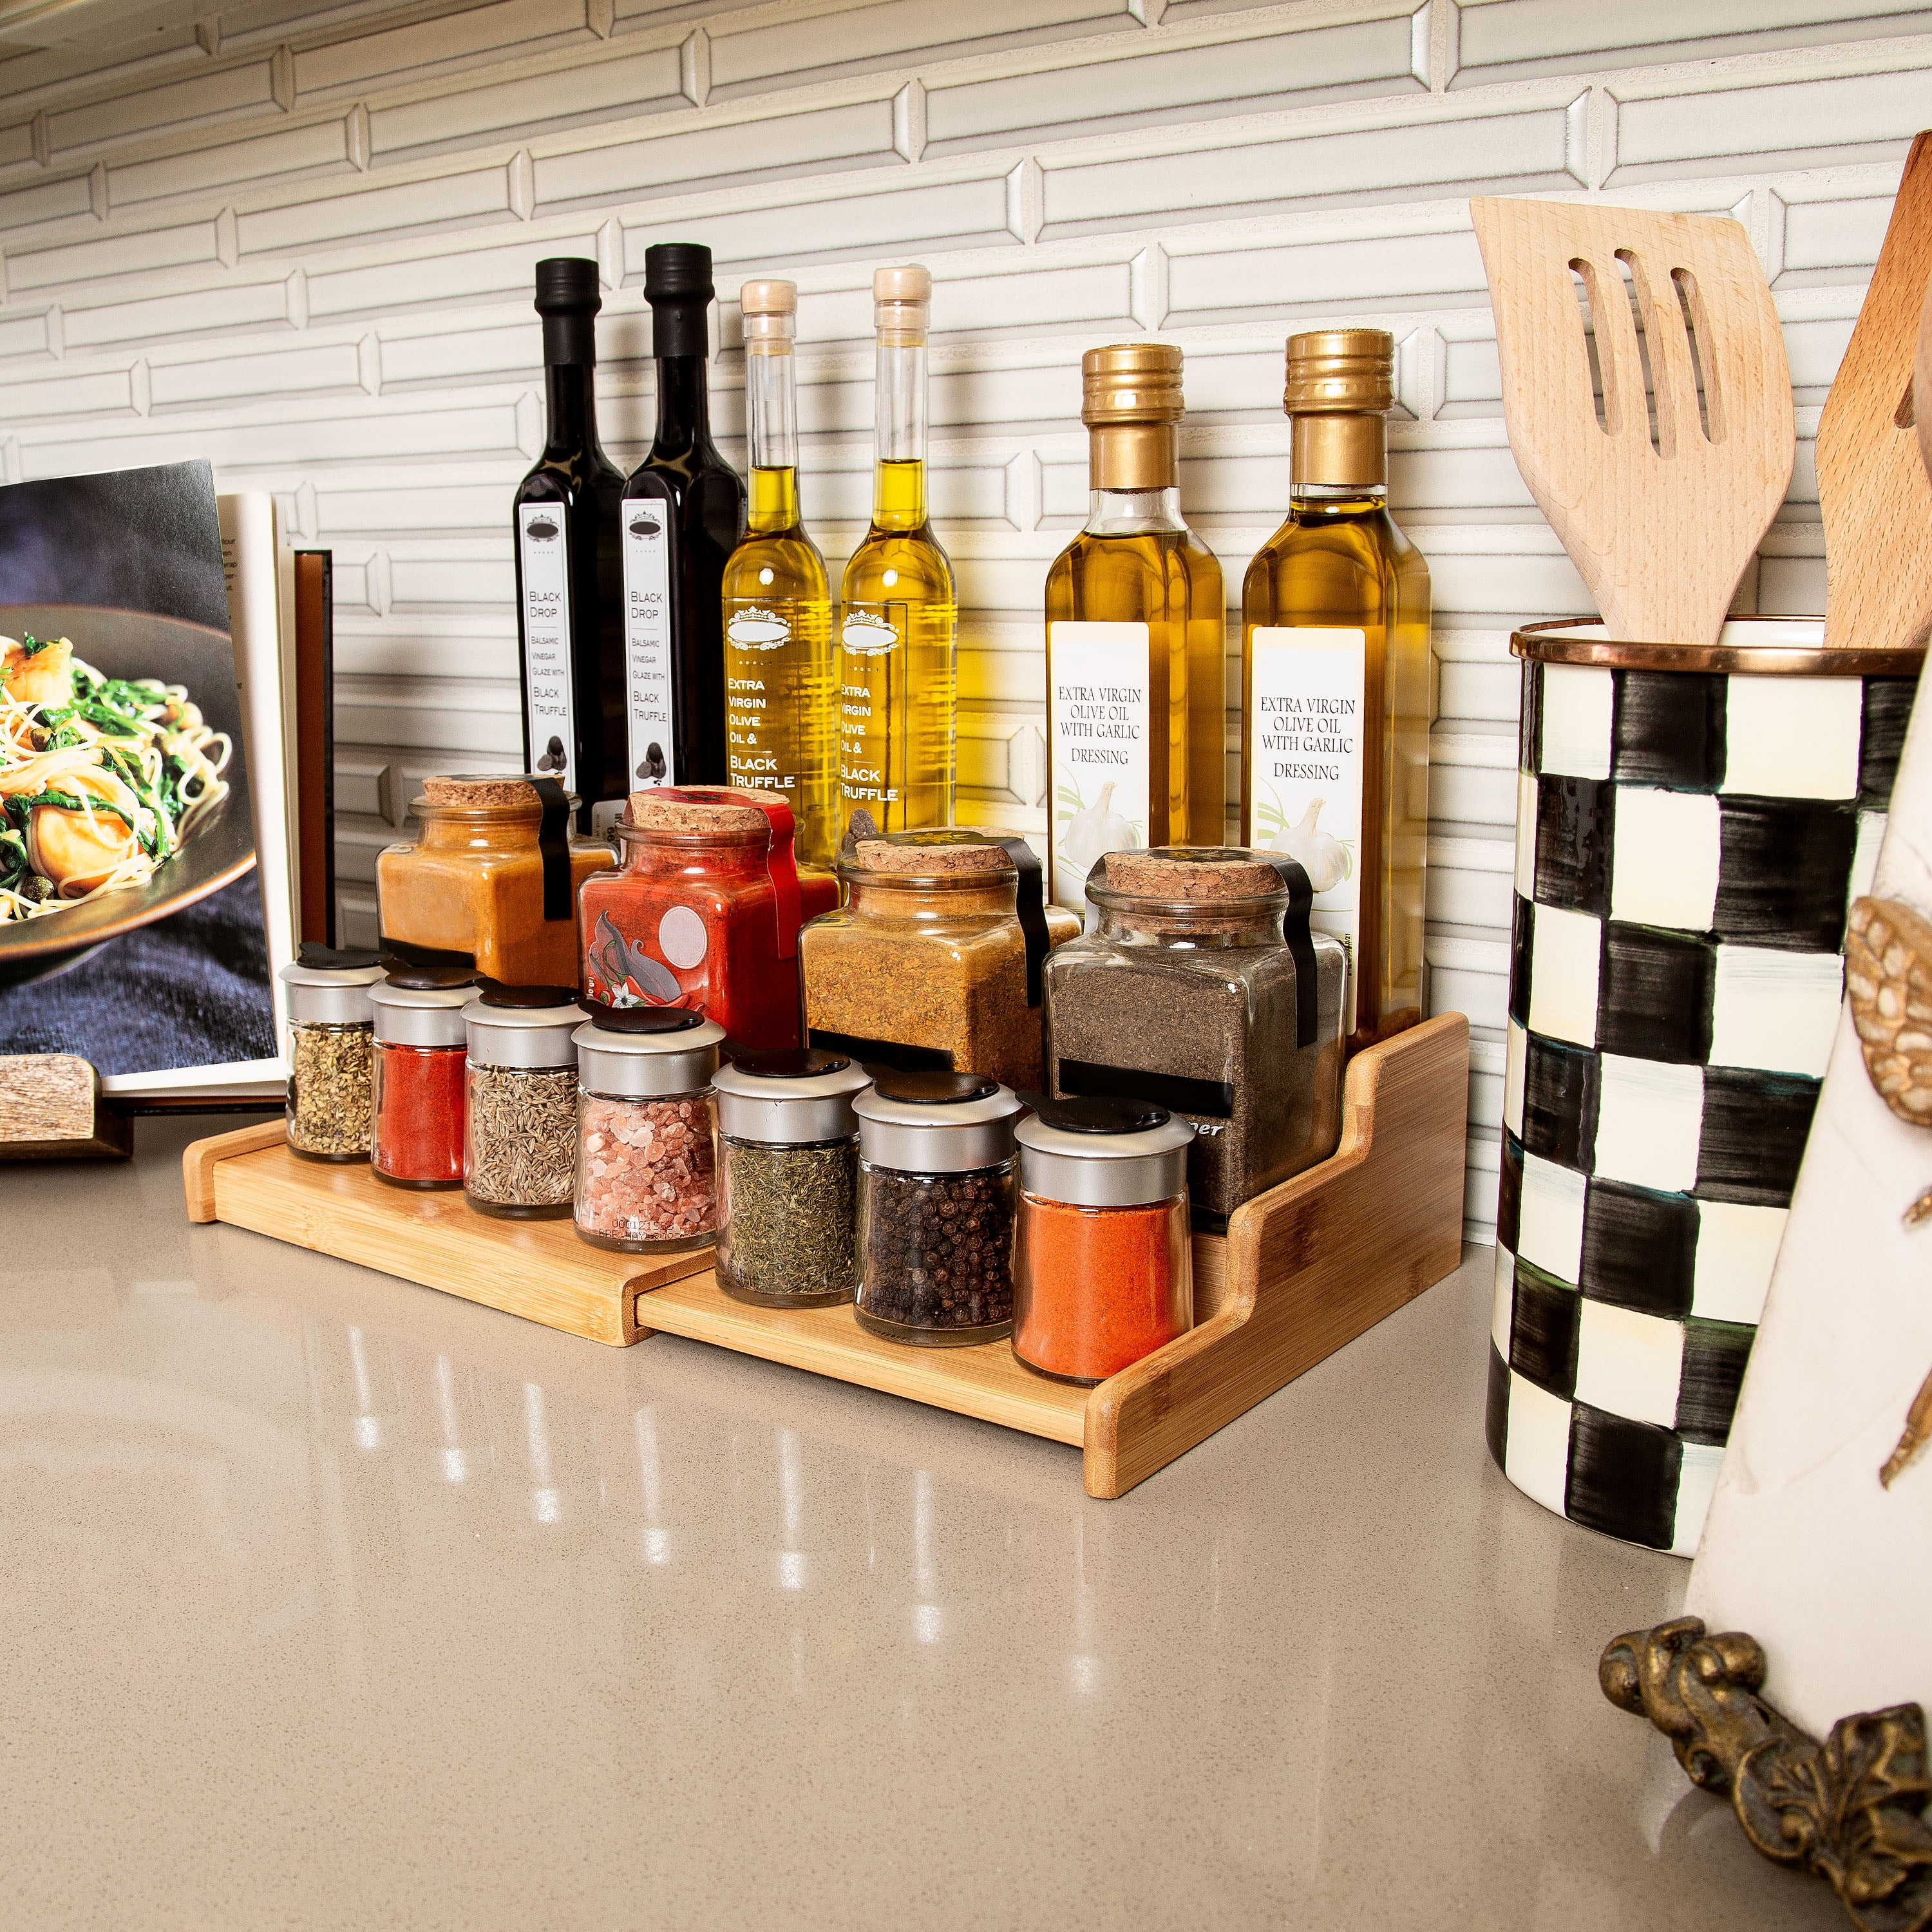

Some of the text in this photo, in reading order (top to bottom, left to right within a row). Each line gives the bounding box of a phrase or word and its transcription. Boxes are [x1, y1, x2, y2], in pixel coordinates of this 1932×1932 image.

[530, 591, 562, 601] BLACK
[631, 591, 663, 603] BLACK
[530, 607, 557, 618] DROP
[631, 607, 658, 619] DROP
[531, 636, 559, 645] BALSAMIC
[632, 638, 659, 647] BALSAMIC
[632, 654, 656, 663] VINEGAR
[532, 667, 551, 676] GLAZE
[632, 670, 651, 679] GLAZE
[728, 678, 765, 690] EXTRA
[534, 687, 559, 698] BLACK
[841, 684, 871, 697] EXTRA
[1059, 687, 1141, 703] EXTRA VIRGIN
[634, 691, 659, 703] BLACK
[728, 696, 766, 708] VIRGIN
[535, 704, 567, 716] TRUFFLE
[1261, 697, 1355, 714] EXTRA VIRGIN
[634, 709, 667, 722] TRUFFLE
[1070, 705, 1129, 720] OLIVE OIL
[729, 714, 761, 726] OLIVE
[1274, 717, 1341, 734] OLIVE OIL
[1061, 722, 1140, 739] WITH GARLIC
[730, 732, 757, 744] OIL &
[1262, 735, 1353, 753] WITH GARLIC
[853, 741, 862, 753] &
[1072, 748, 1128, 764] DRESSING
[730, 755, 777, 770] BLACK
[841, 764, 880, 782] BLACK
[1274, 762, 1339, 781] DRESSING
[730, 773, 795, 788] TRUFFLE
[841, 782, 898, 801] TRUFFLE
